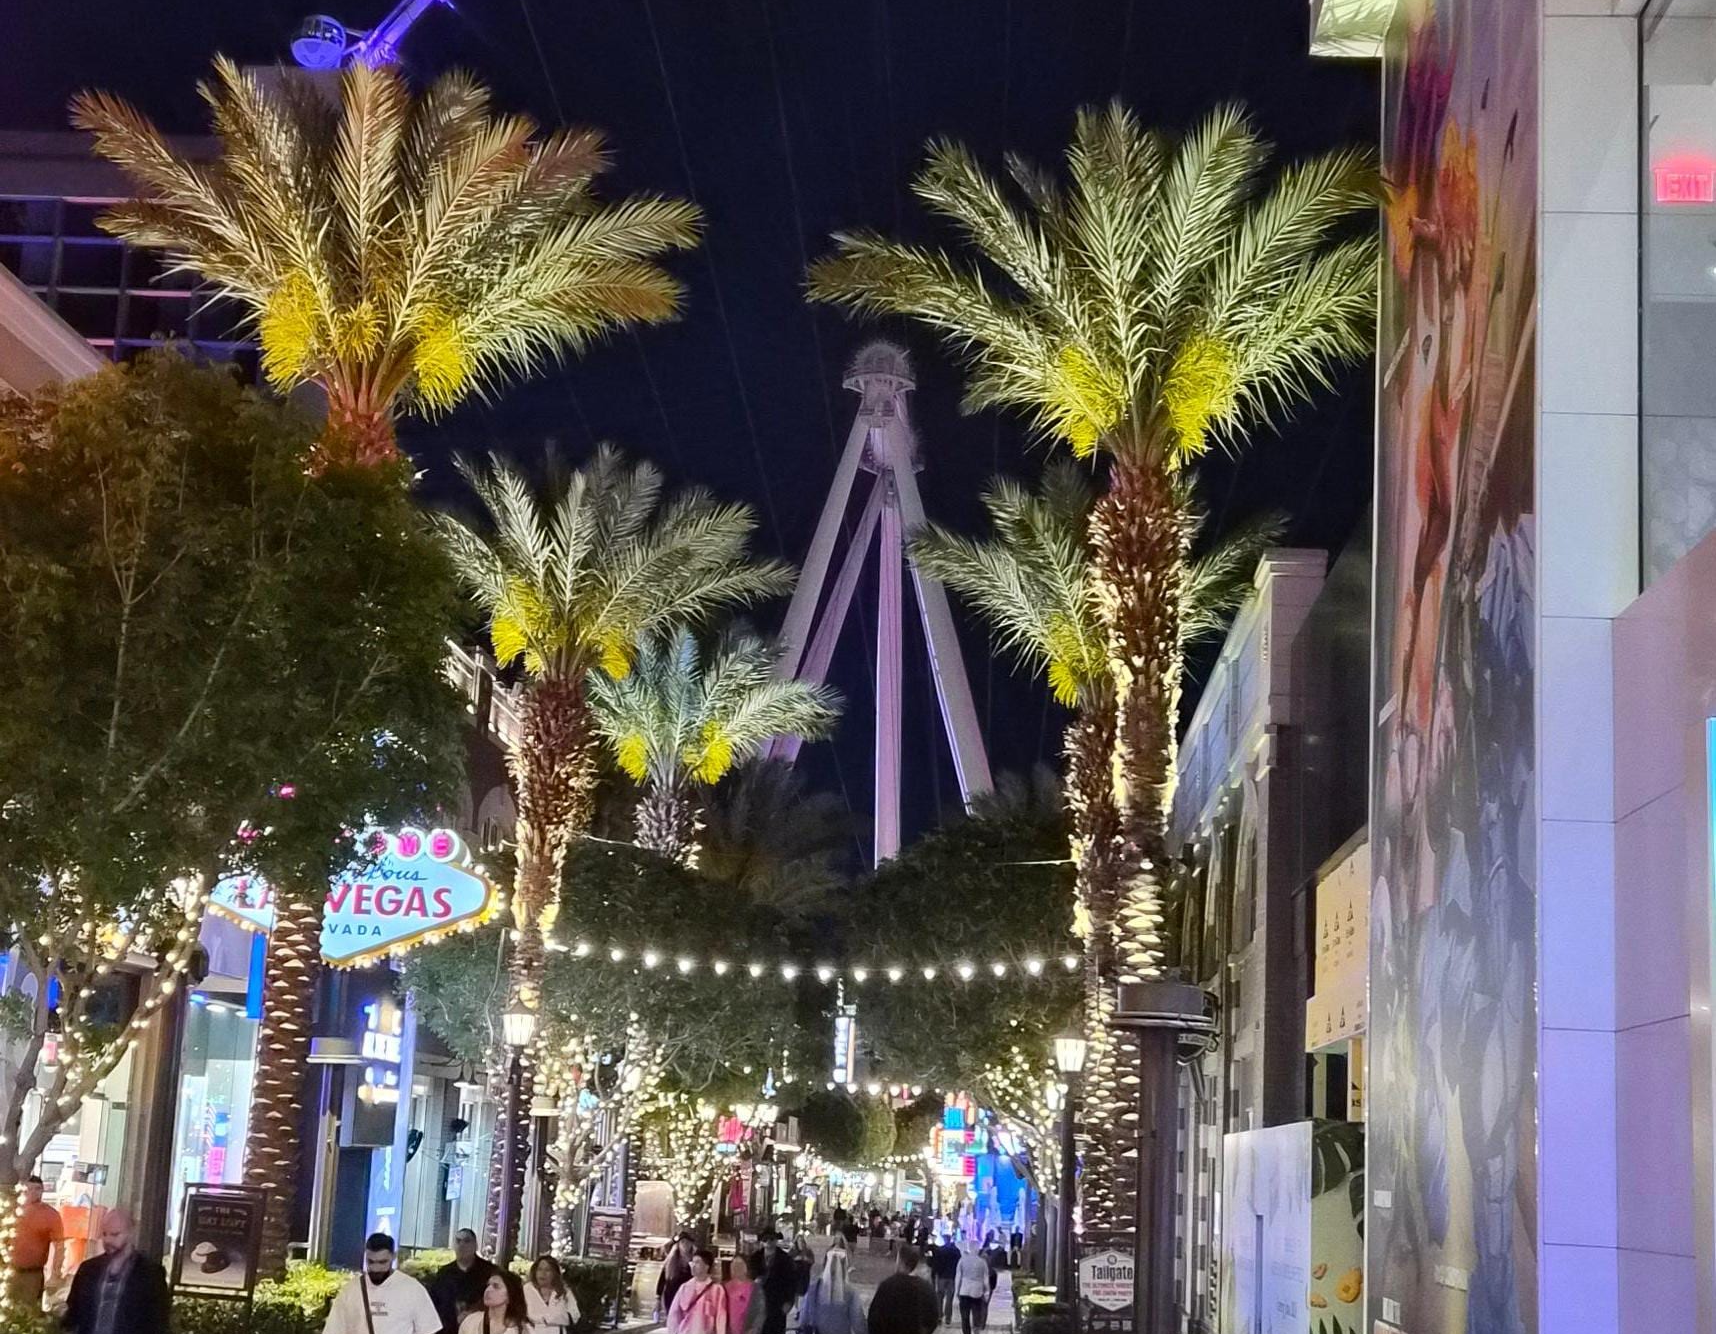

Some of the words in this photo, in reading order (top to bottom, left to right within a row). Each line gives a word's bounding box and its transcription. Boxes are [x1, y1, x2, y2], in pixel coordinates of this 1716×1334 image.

[1666, 173, 1709, 198] EXIT
[326, 883, 453, 918] VEGAS
[328, 923, 382, 937] VADA
[1091, 1265, 1133, 1281] Tailgate
